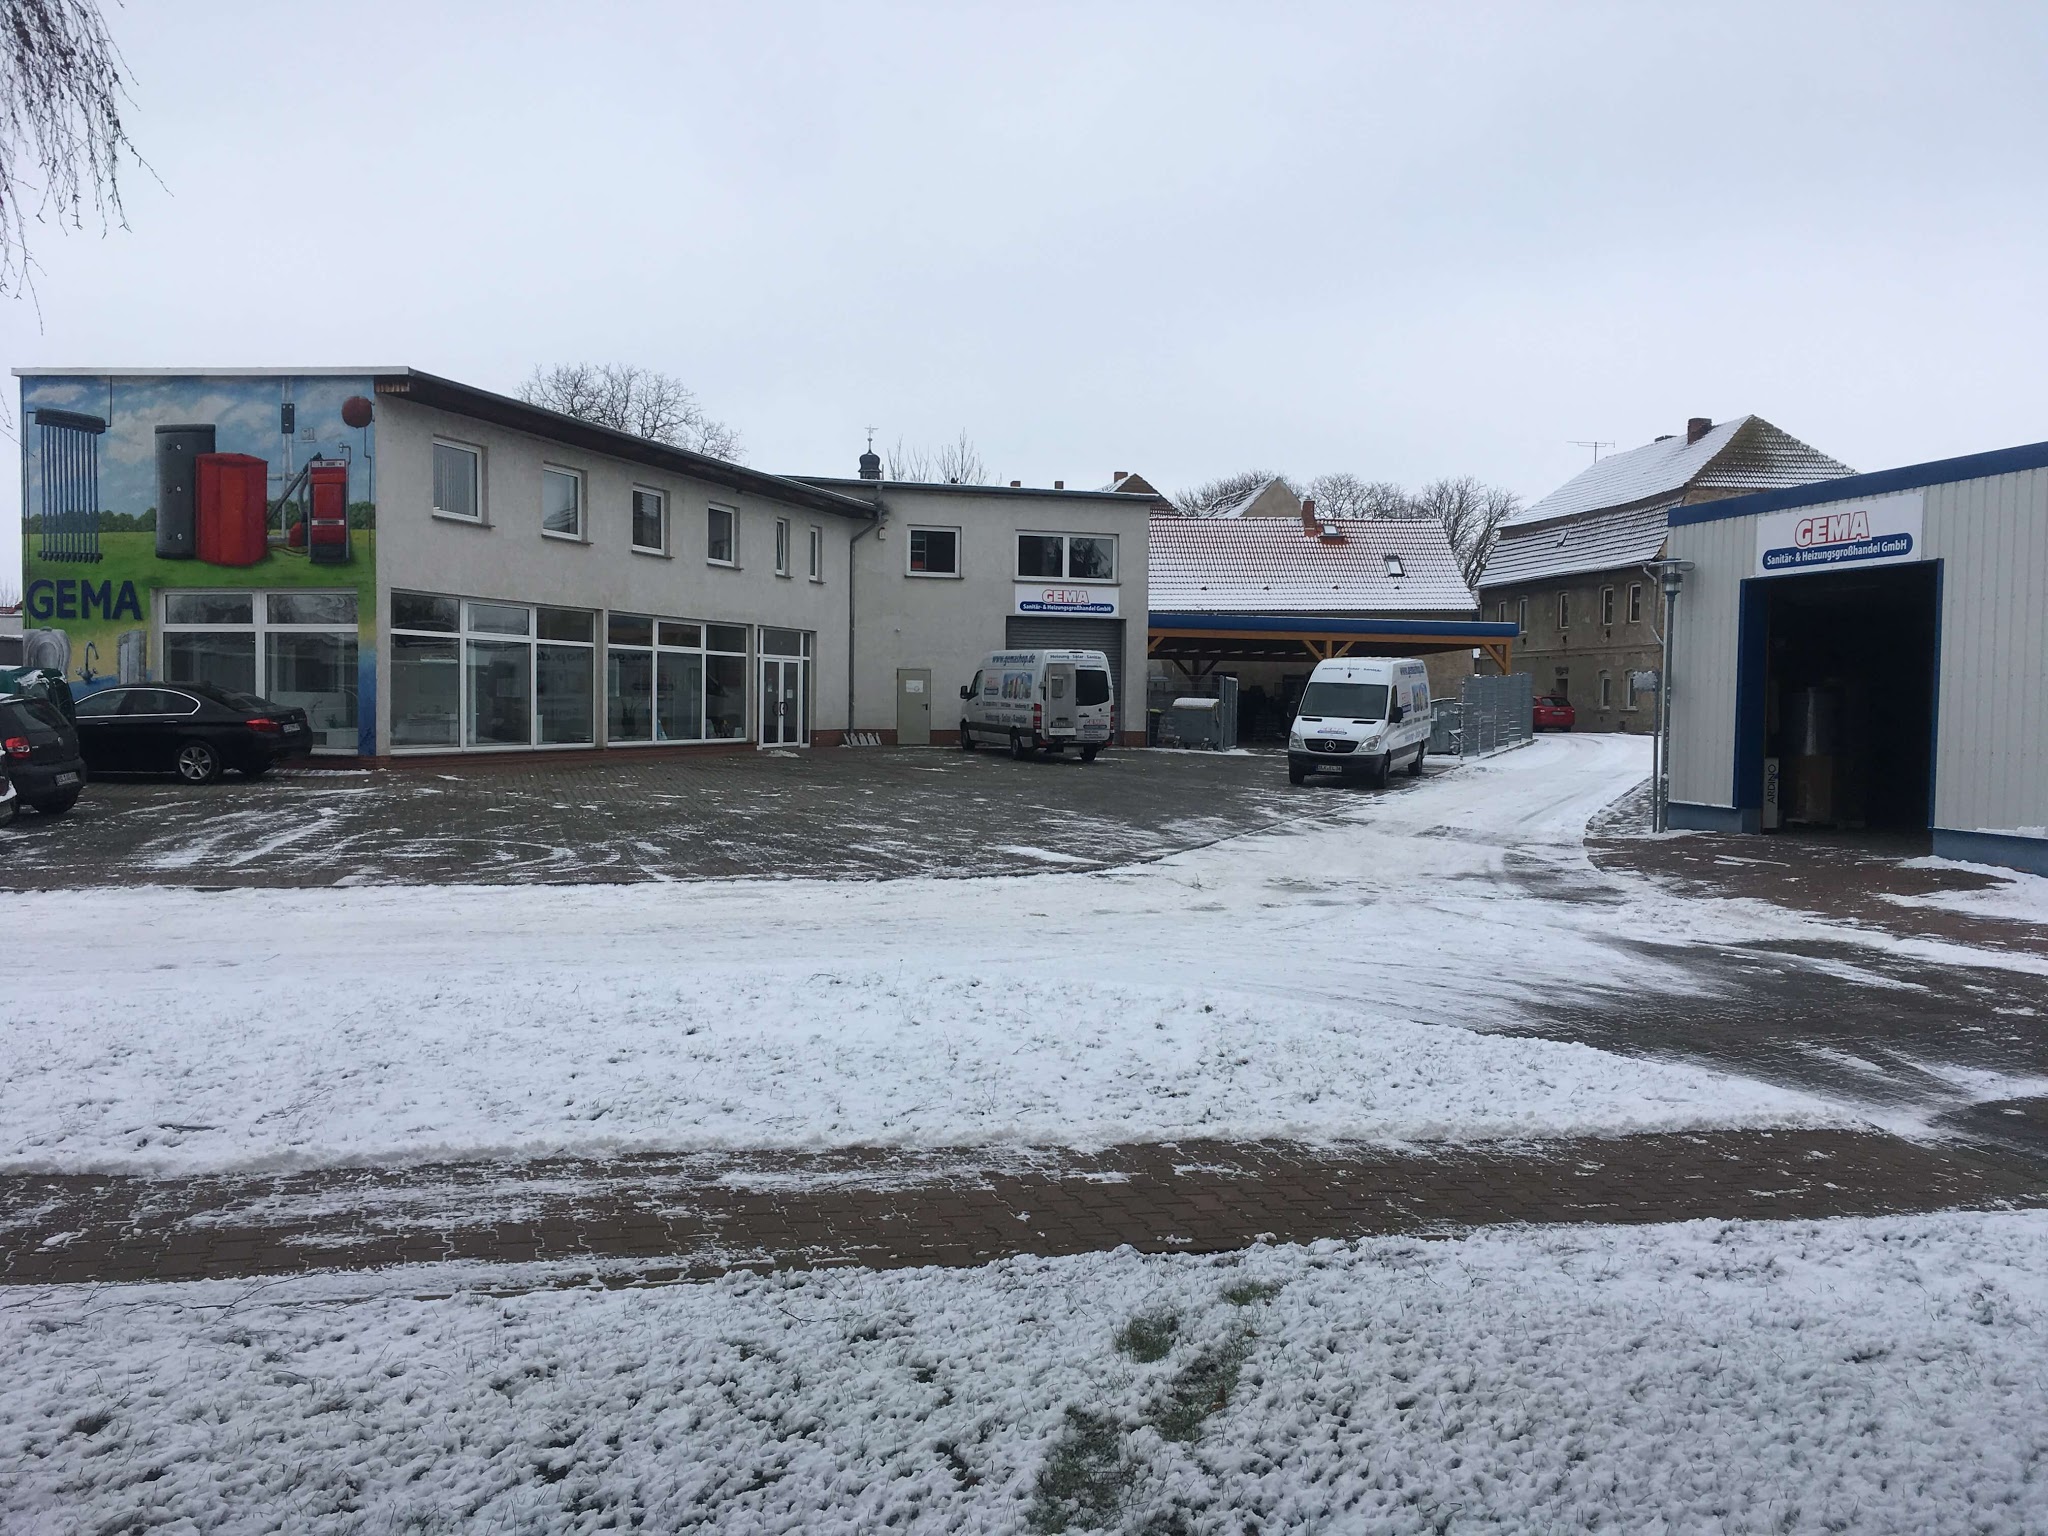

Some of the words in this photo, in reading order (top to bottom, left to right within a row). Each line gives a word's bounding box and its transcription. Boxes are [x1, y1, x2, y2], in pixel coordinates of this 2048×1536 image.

[1795, 510, 1870, 548] GEMA
[1766, 552, 1794, 565] Sanitär-
[1795, 553, 1801, 562] &
[1802, 543, 1881, 562] Heizungsgroßhandel
[1881, 538, 1907, 552] GmbH
[26, 578, 144, 620] GEMA
[1042, 589, 1089, 604] GEMA
[1767, 763, 1776, 804] ARDINO
